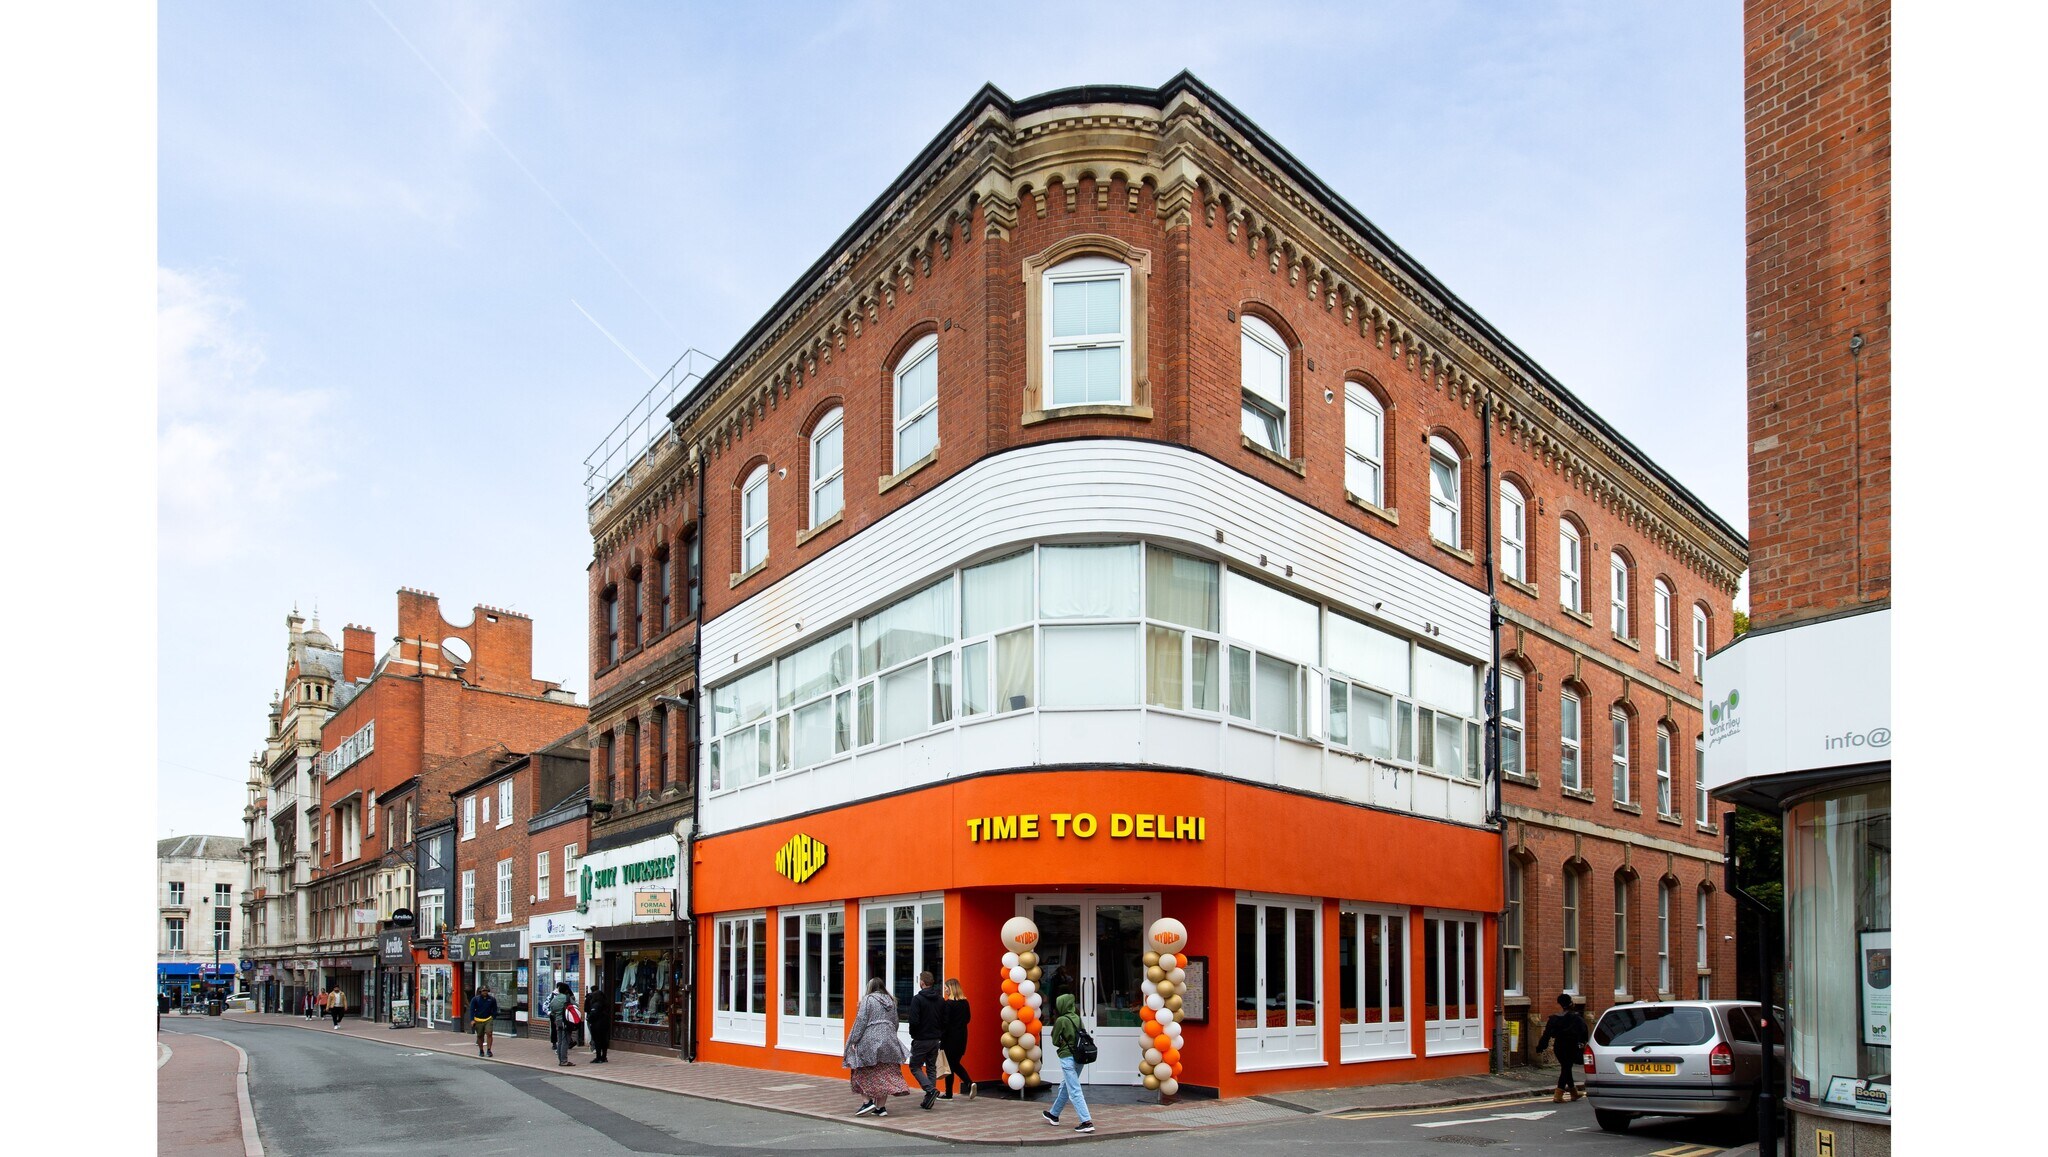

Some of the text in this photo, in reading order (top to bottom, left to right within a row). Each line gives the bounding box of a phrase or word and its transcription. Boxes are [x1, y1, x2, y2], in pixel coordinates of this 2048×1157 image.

[1709, 689, 1740, 725] brp
[1710, 717, 1741, 737] brink riley
[1825, 727, 1891, 750] info@
[966, 813, 1206, 842] TIME TO DELHI
[621, 854, 676, 885] YOURSELF
[1628, 1064, 1672, 1072] DA04 ULD
[1856, 1087, 1886, 1099] Boom
